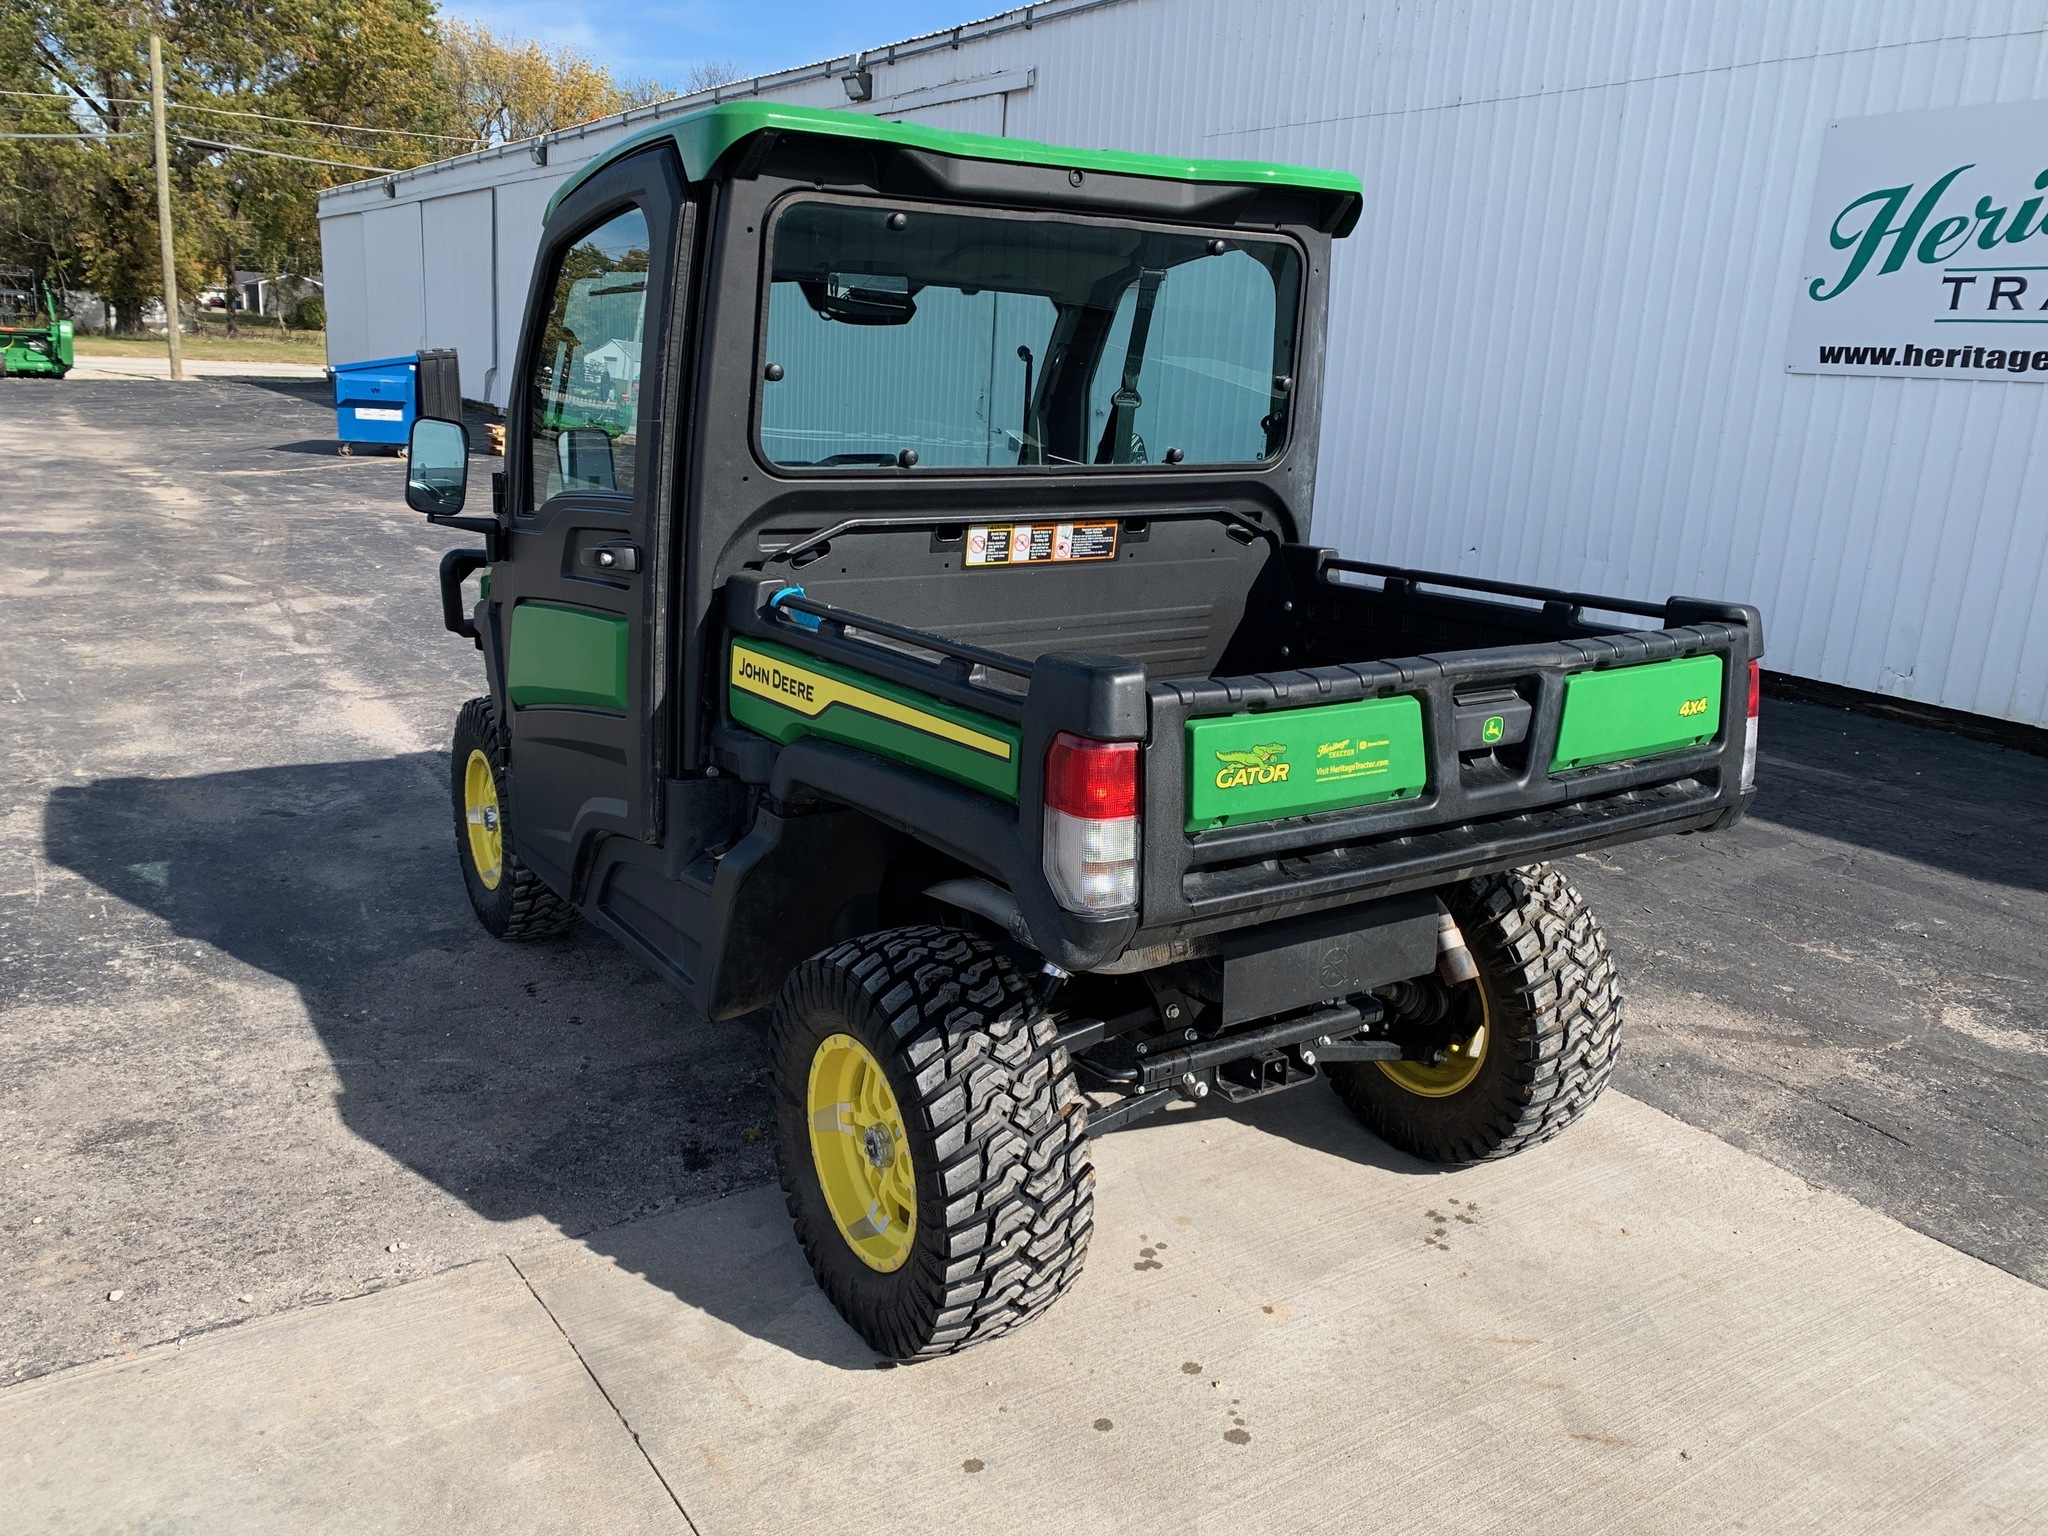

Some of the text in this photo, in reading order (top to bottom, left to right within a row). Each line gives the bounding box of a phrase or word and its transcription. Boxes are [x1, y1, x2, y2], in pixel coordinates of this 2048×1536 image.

[1809, 163, 2048, 301] Heri
[1942, 276, 2048, 311] TR
[739, 657, 814, 703] JOHN DEERE
[1316, 739, 1350, 758] Heritage
[1216, 763, 1290, 789] GATOR
[1330, 760, 1389, 773] HeritageTractor.com
